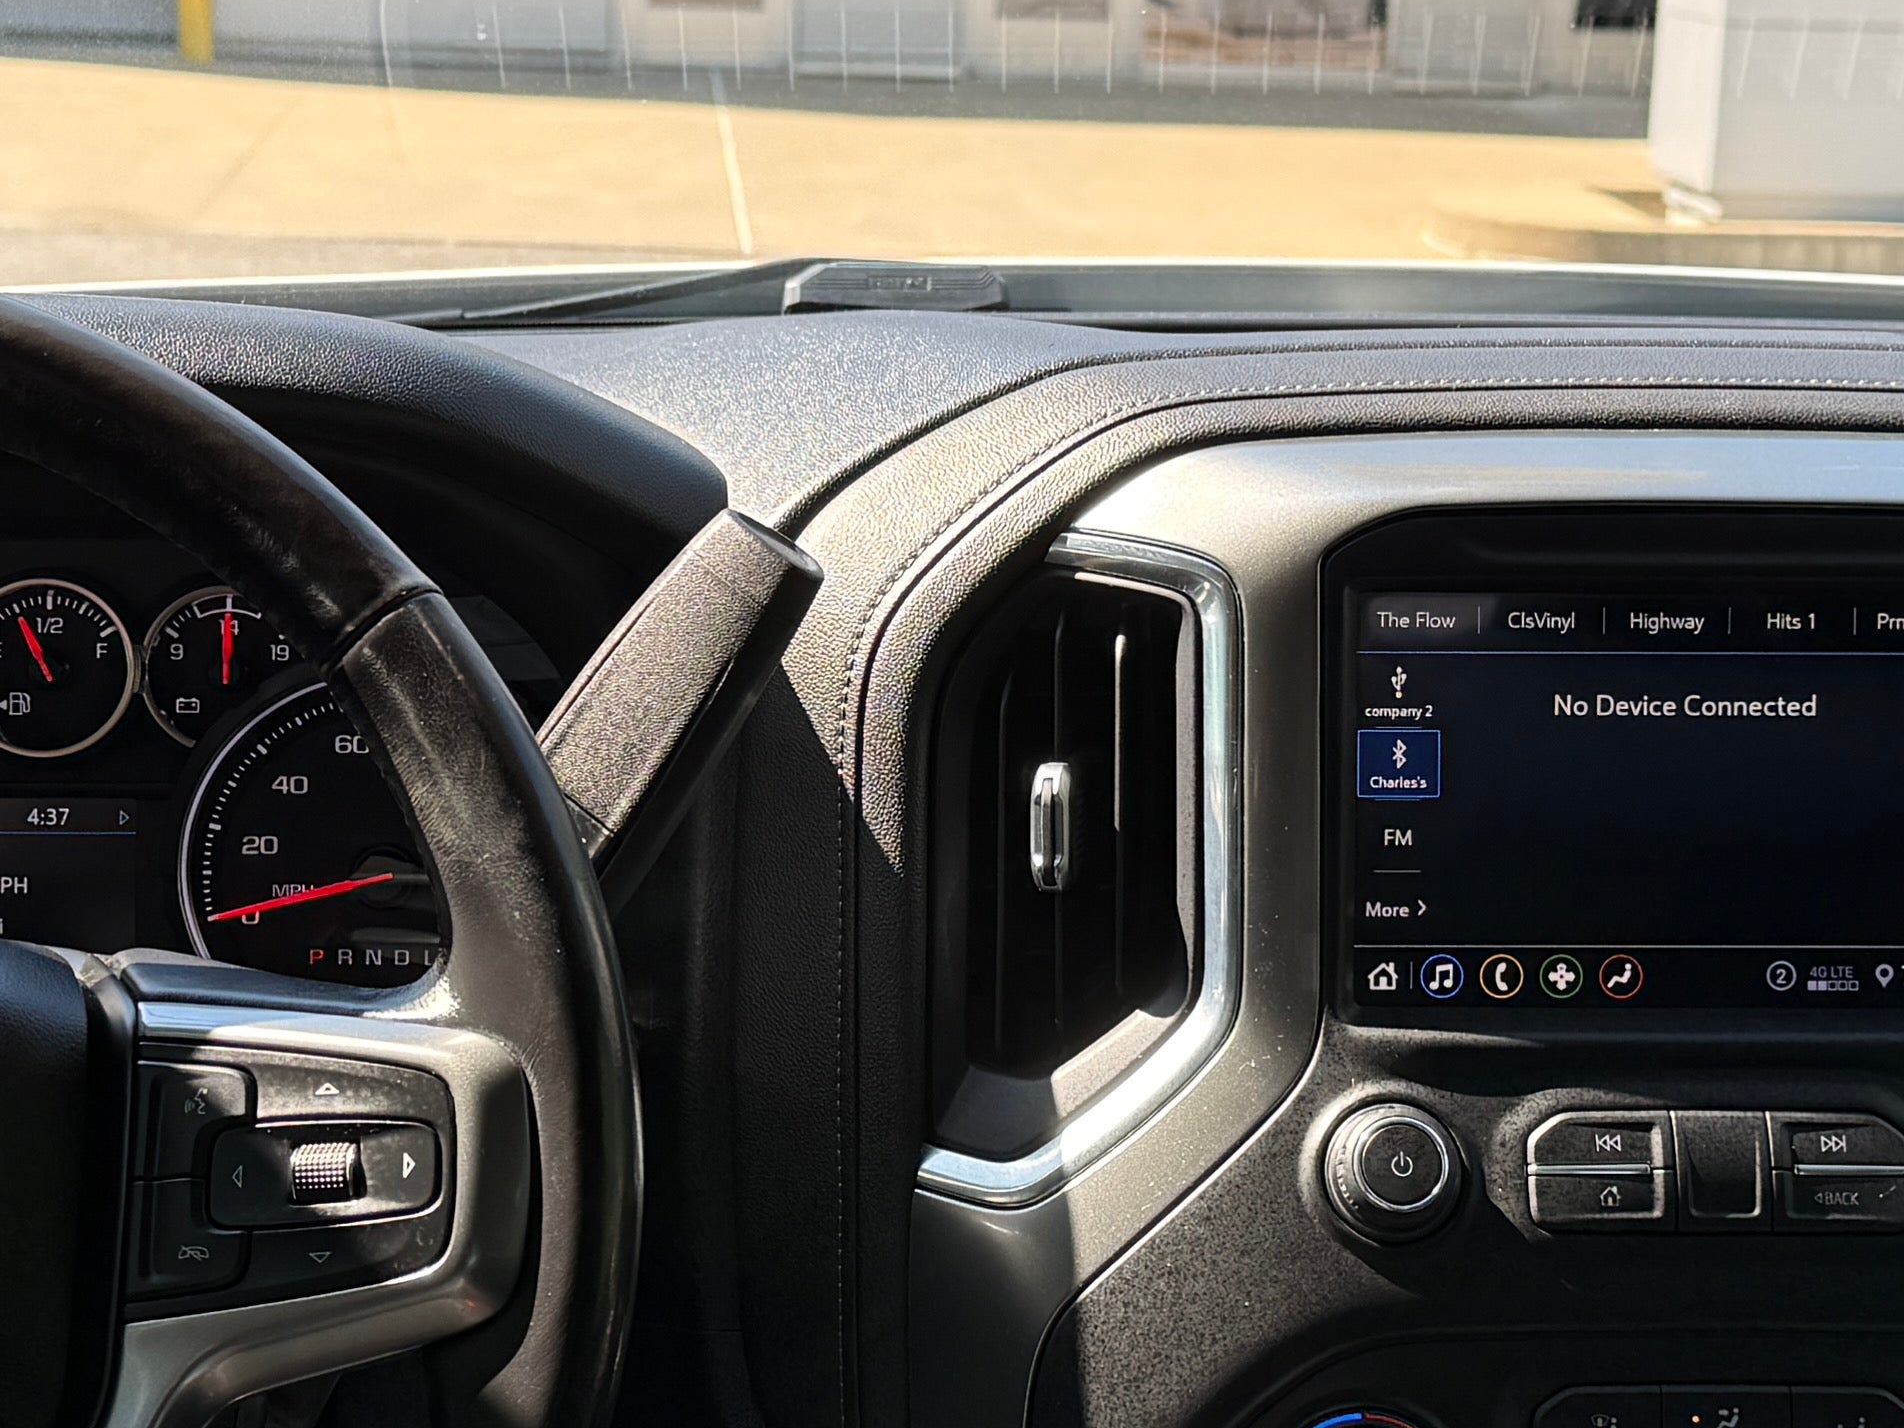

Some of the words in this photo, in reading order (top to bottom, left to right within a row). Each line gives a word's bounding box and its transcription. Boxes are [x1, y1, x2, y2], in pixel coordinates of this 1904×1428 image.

[36, 616, 64, 635] 1/2
[1376, 611, 1409, 630] The
[1413, 611, 1456, 630] Flow
[1506, 611, 1576, 635] ClsVinyl
[1629, 611, 1705, 636] Highway
[1766, 611, 1800, 631] Hits
[1807, 612, 1816, 631] 1
[96, 642, 109, 660] F
[169, 643, 184, 661] 9
[270, 644, 290, 662] 19
[1423, 704, 1434, 718] 2
[1553, 694, 1590, 718] No
[1596, 693, 1677, 718] Device
[1682, 693, 1818, 718] Connected
[334, 734, 370, 755] 60
[271, 775, 309, 795] 40
[1369, 775, 1428, 790] Charles's
[26, 806, 71, 828] 4:37
[241, 835, 279, 856] 20
[1383, 828, 1413, 847] FM
[1365, 901, 1410, 919] More
[309, 949, 325, 965] P
[338, 949, 353, 965] R
[365, 949, 382, 965] N
[395, 949, 410, 965] D
[1809, 966, 1831, 979] 4G
[1833, 966, 1854, 978] LTE
[1823, 1189, 1860, 1208] BACK
